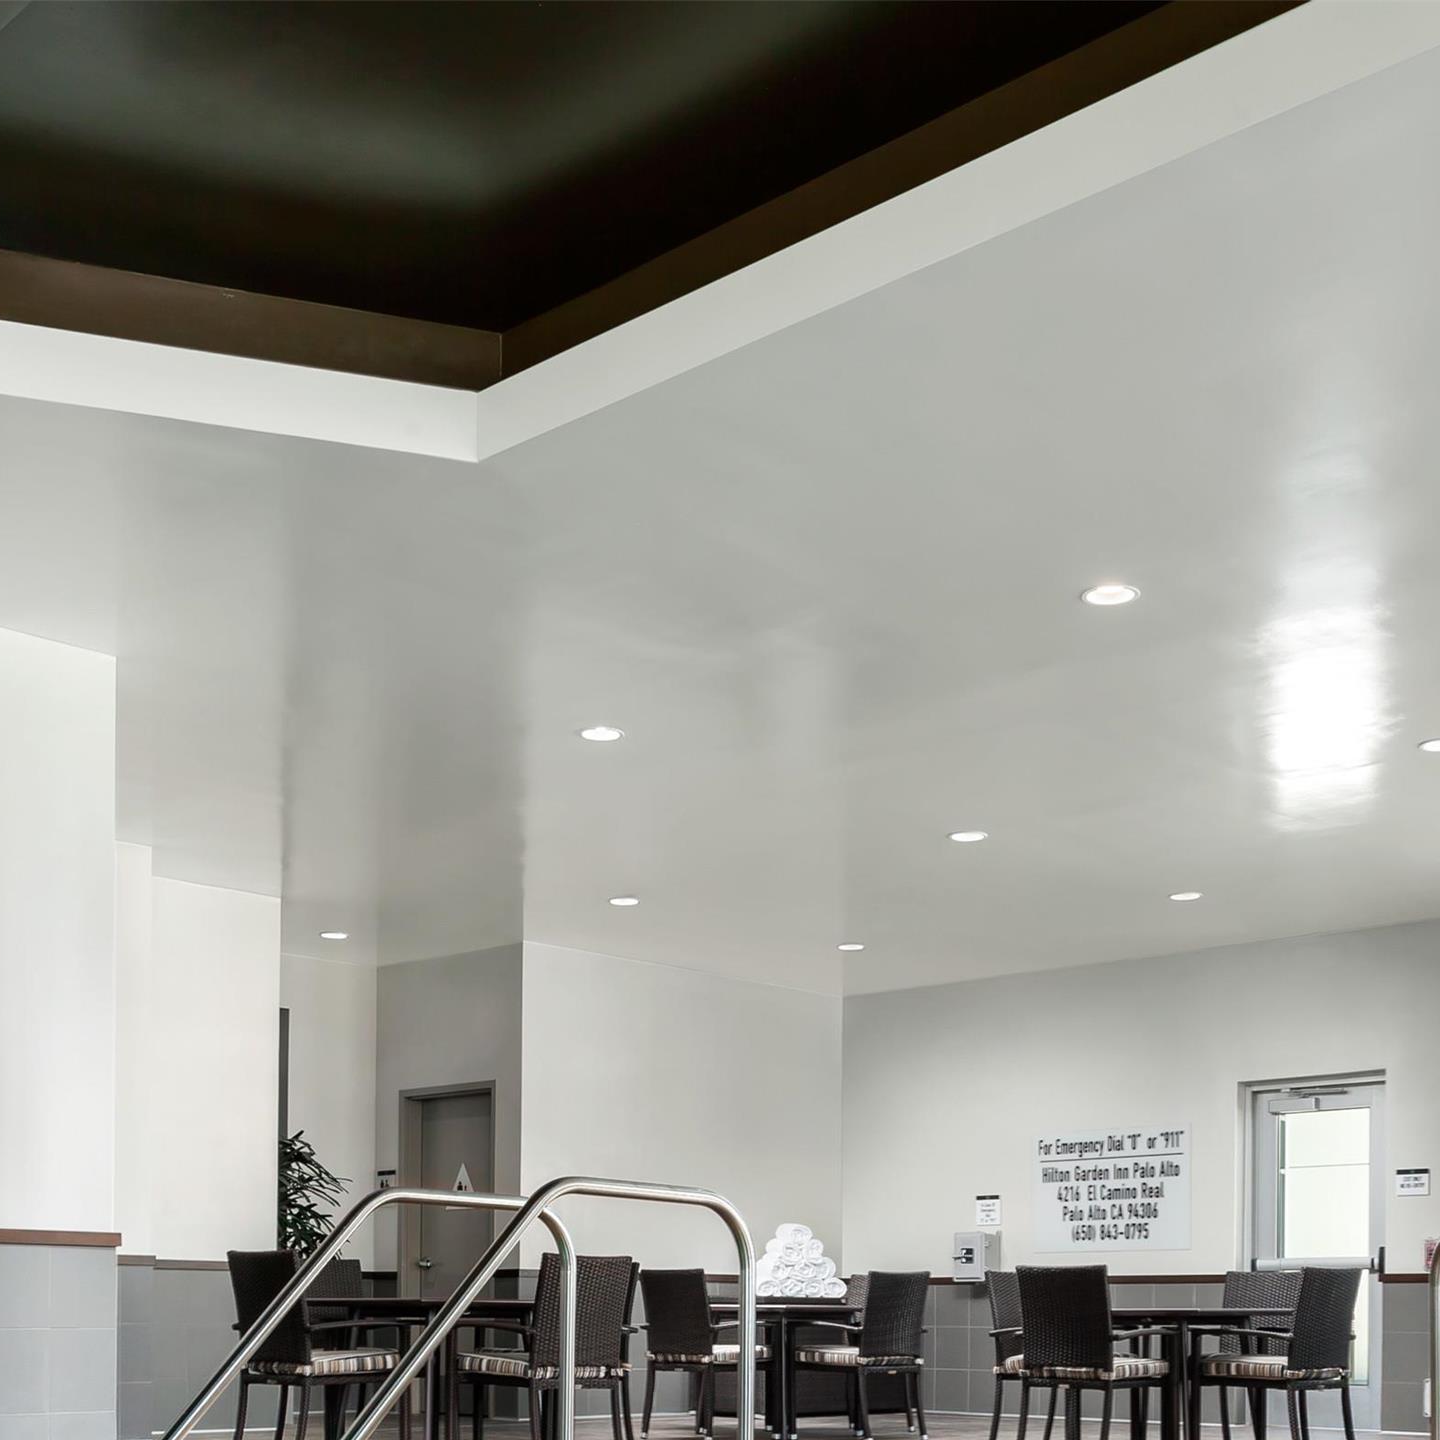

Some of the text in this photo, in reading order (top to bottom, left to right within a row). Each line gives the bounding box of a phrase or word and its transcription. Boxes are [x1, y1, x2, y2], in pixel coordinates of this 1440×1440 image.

[1038, 1139, 1052, 1156] For
[1055, 1138, 1104, 1157] Emergency
[1107, 1135, 1124, 1152] Dial
[1147, 1136, 1157, 1149] or
[1042, 1160, 1180, 1182] Hilton Garden Inn Palo Alto
[1088, 1184, 1096, 1201] El
[1100, 1183, 1137, 1200] Camino
[1141, 1181, 1164, 1198] Real
[1063, 1202, 1158, 1221] Palo Alto CA 94306
[1072, 1222, 1149, 1242] (650) 843-0795
